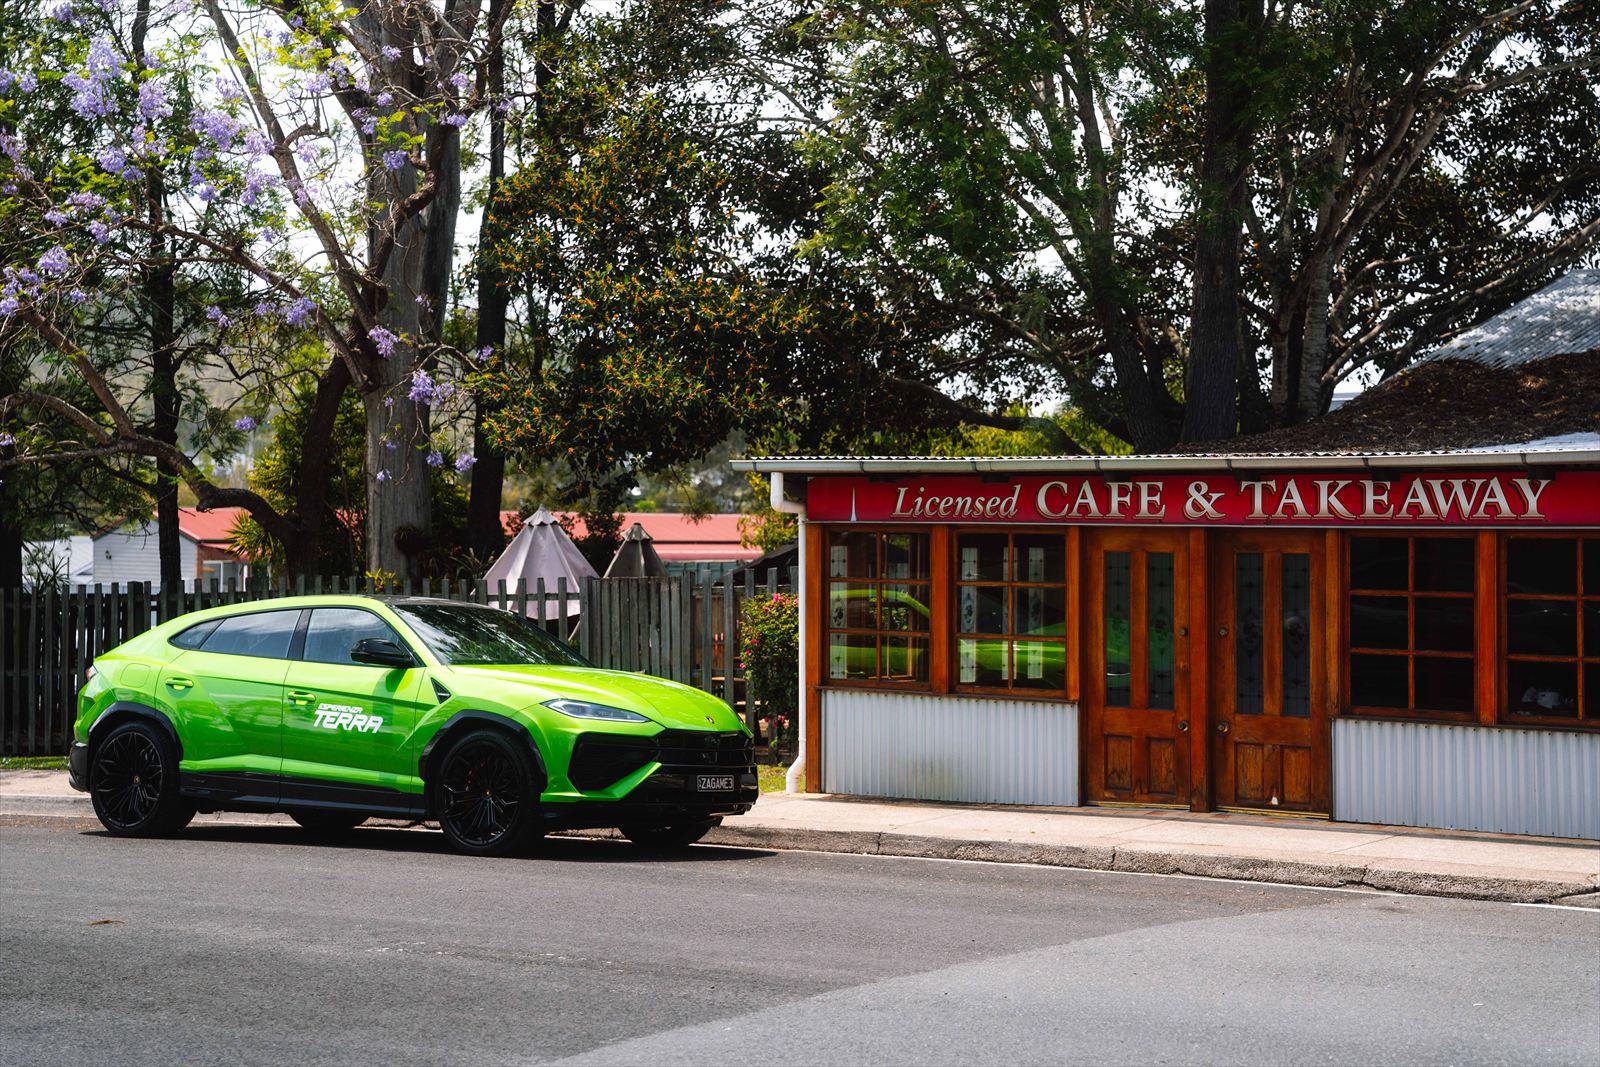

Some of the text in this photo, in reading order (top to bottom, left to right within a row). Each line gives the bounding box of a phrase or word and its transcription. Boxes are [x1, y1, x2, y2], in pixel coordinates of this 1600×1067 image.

[891, 478, 1552, 520] Licensed CAFE & TAKEAWAY
[313, 709, 384, 733] TERRA
[701, 777, 733, 789] ZAGAME3
